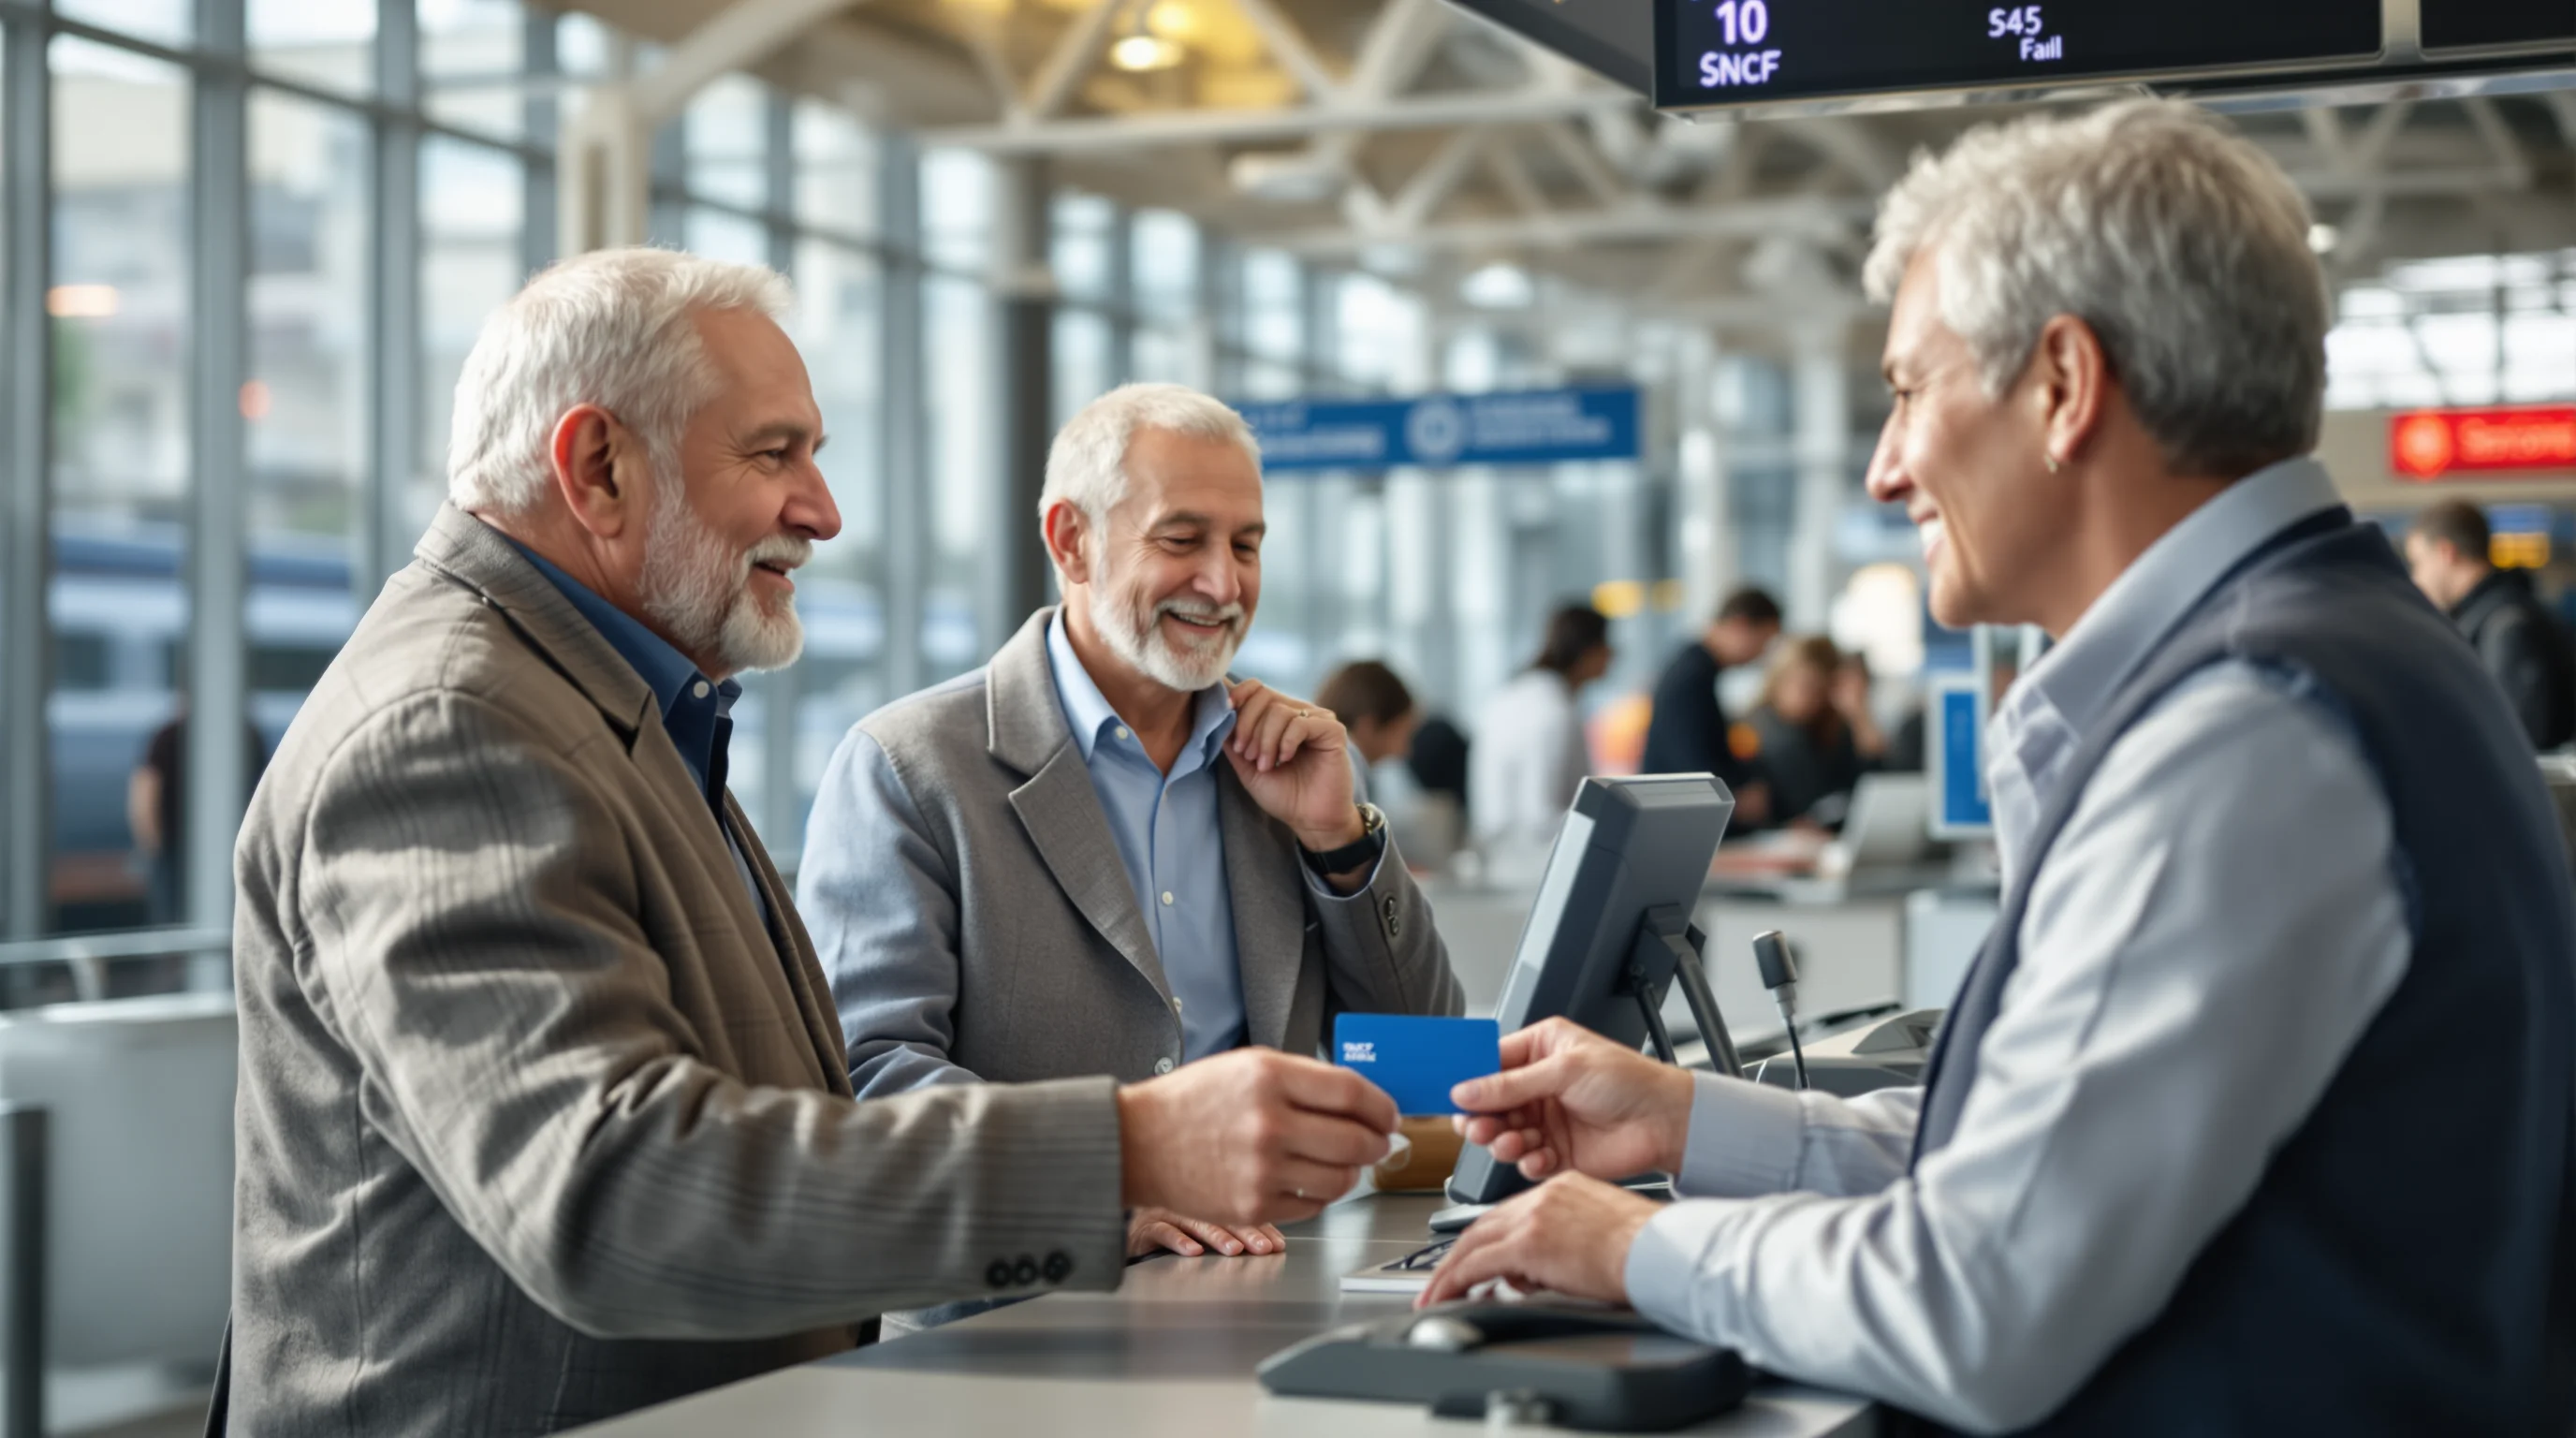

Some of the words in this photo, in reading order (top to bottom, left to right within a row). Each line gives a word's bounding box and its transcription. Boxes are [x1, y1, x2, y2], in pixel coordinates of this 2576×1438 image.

[1715, 0, 1769, 45] 10
[1987, 6, 2043, 38] S45
[1699, 49, 1782, 88] SNCF
